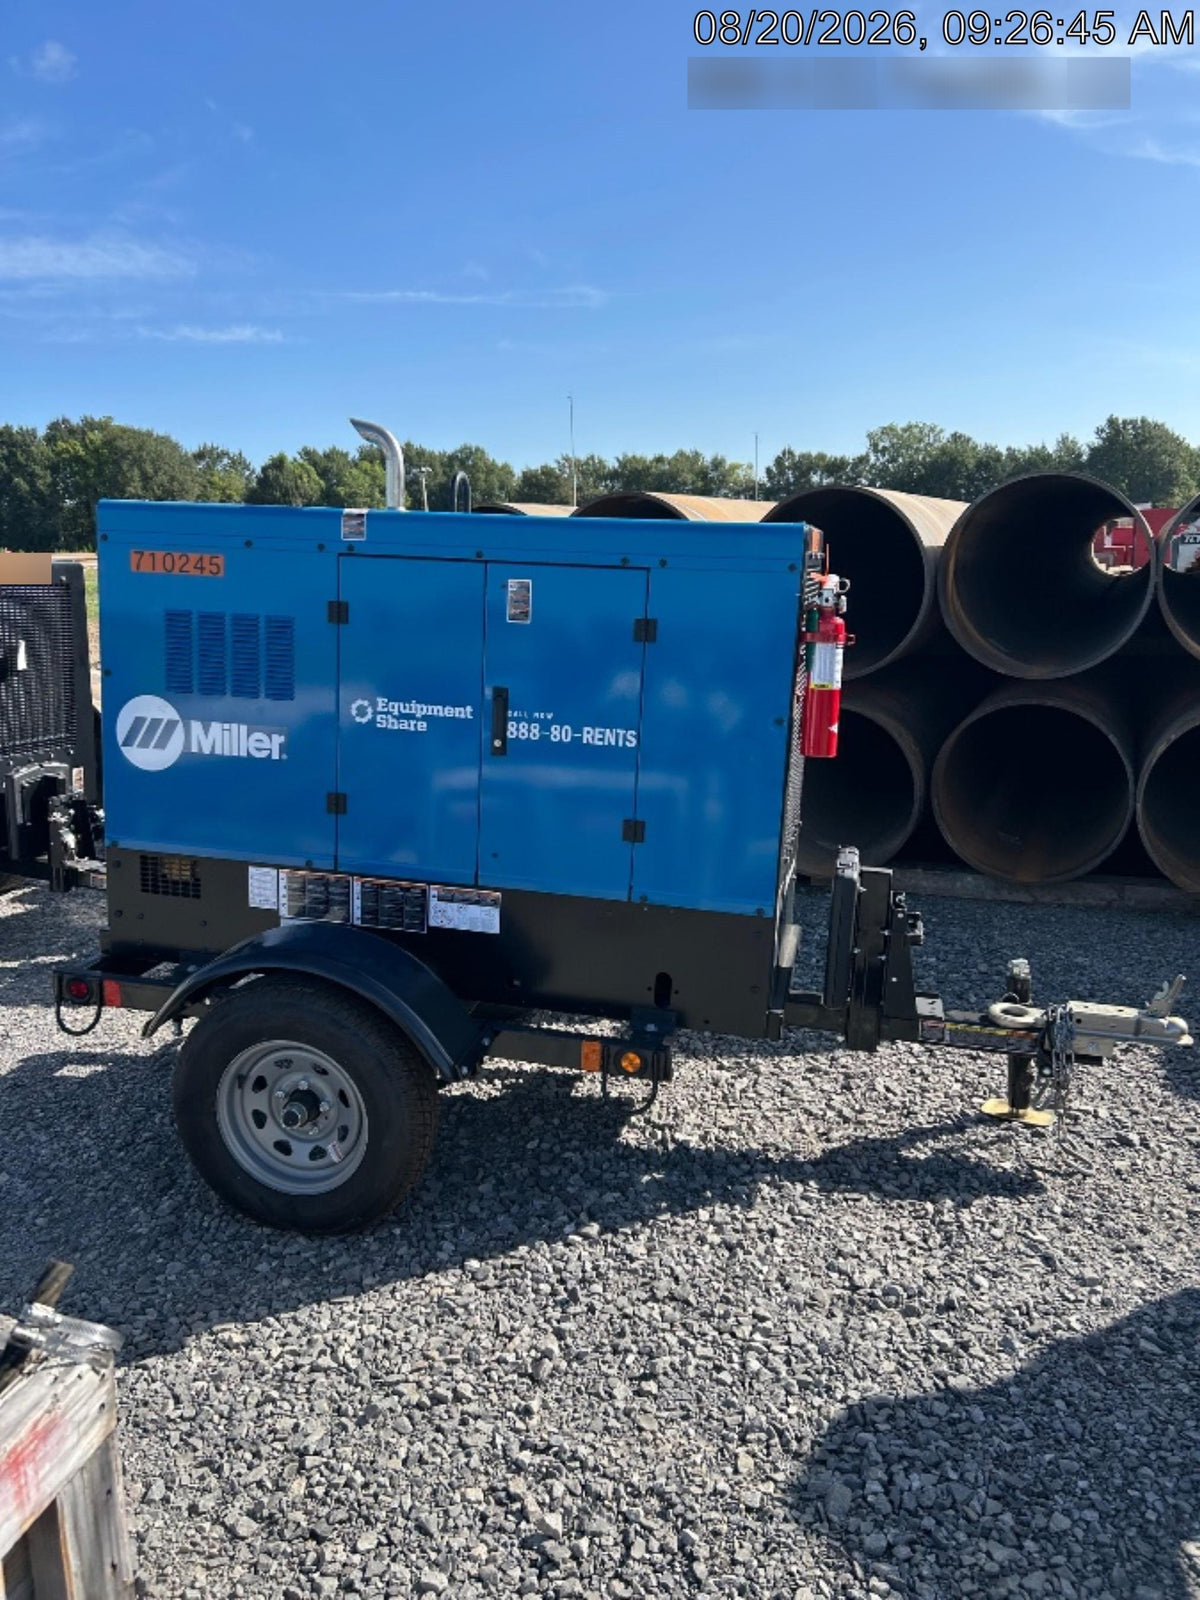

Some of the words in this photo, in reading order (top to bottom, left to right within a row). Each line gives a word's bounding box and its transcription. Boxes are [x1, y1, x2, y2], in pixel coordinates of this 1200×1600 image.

[133, 550, 222, 577] 710245
[376, 697, 474, 719] Equipment
[376, 714, 428, 732] Share
[507, 721, 638, 748] 888-80-RENTS
[190, 720, 286, 760] Miller
